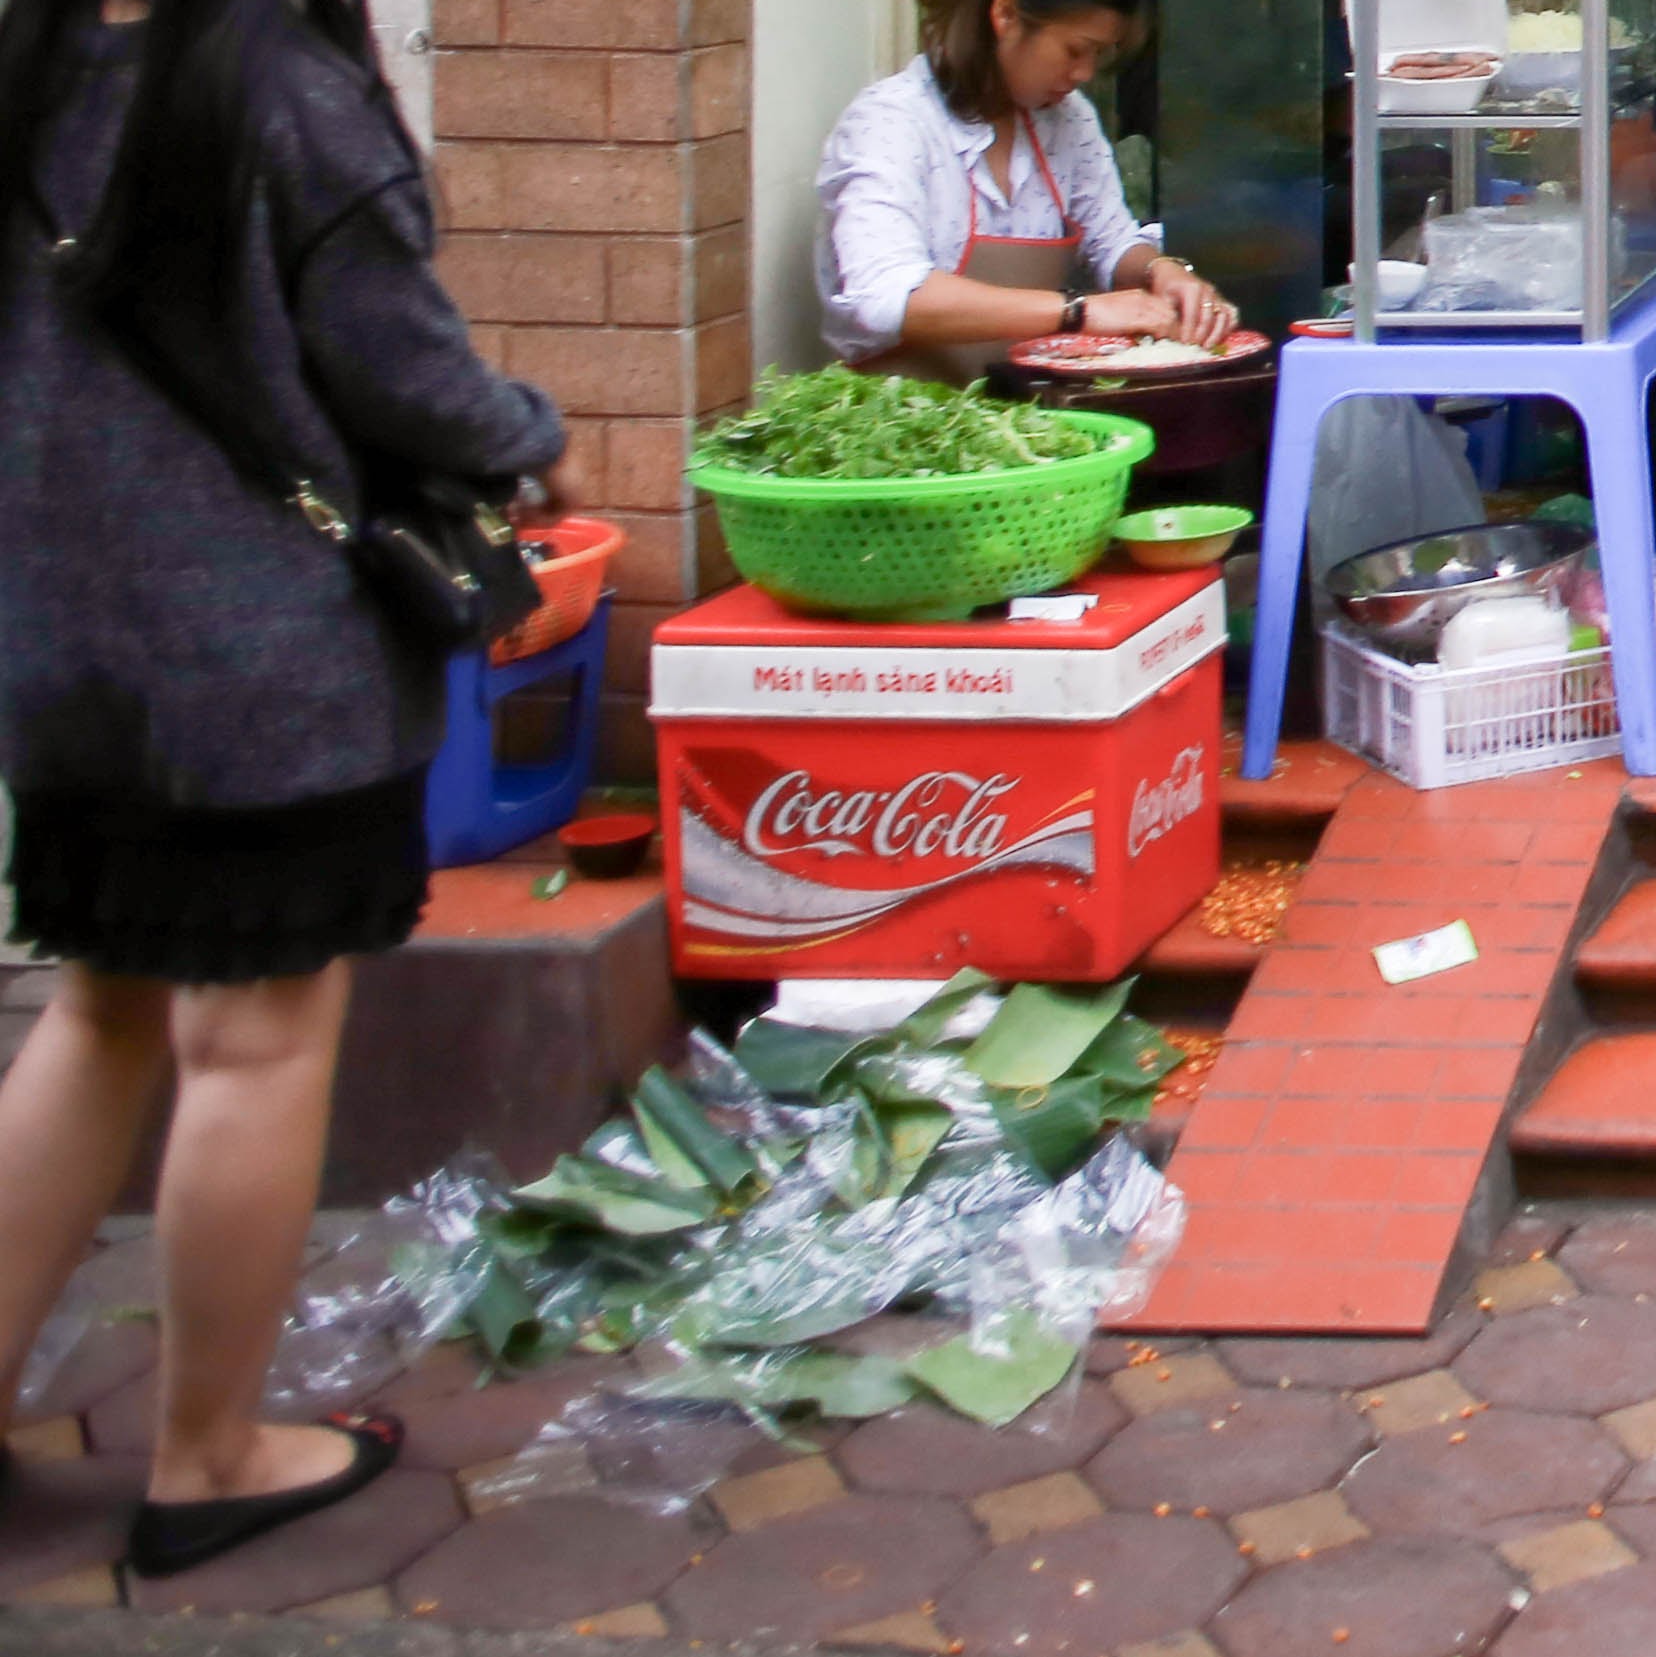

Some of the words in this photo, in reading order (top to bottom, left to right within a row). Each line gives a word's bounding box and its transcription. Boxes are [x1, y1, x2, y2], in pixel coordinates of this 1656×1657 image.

[753, 665, 805, 692] Mát
[812, 666, 867, 699] lạnh
[945, 665, 1014, 694] khoái
[743, 768, 1023, 859] Coca-Cola
